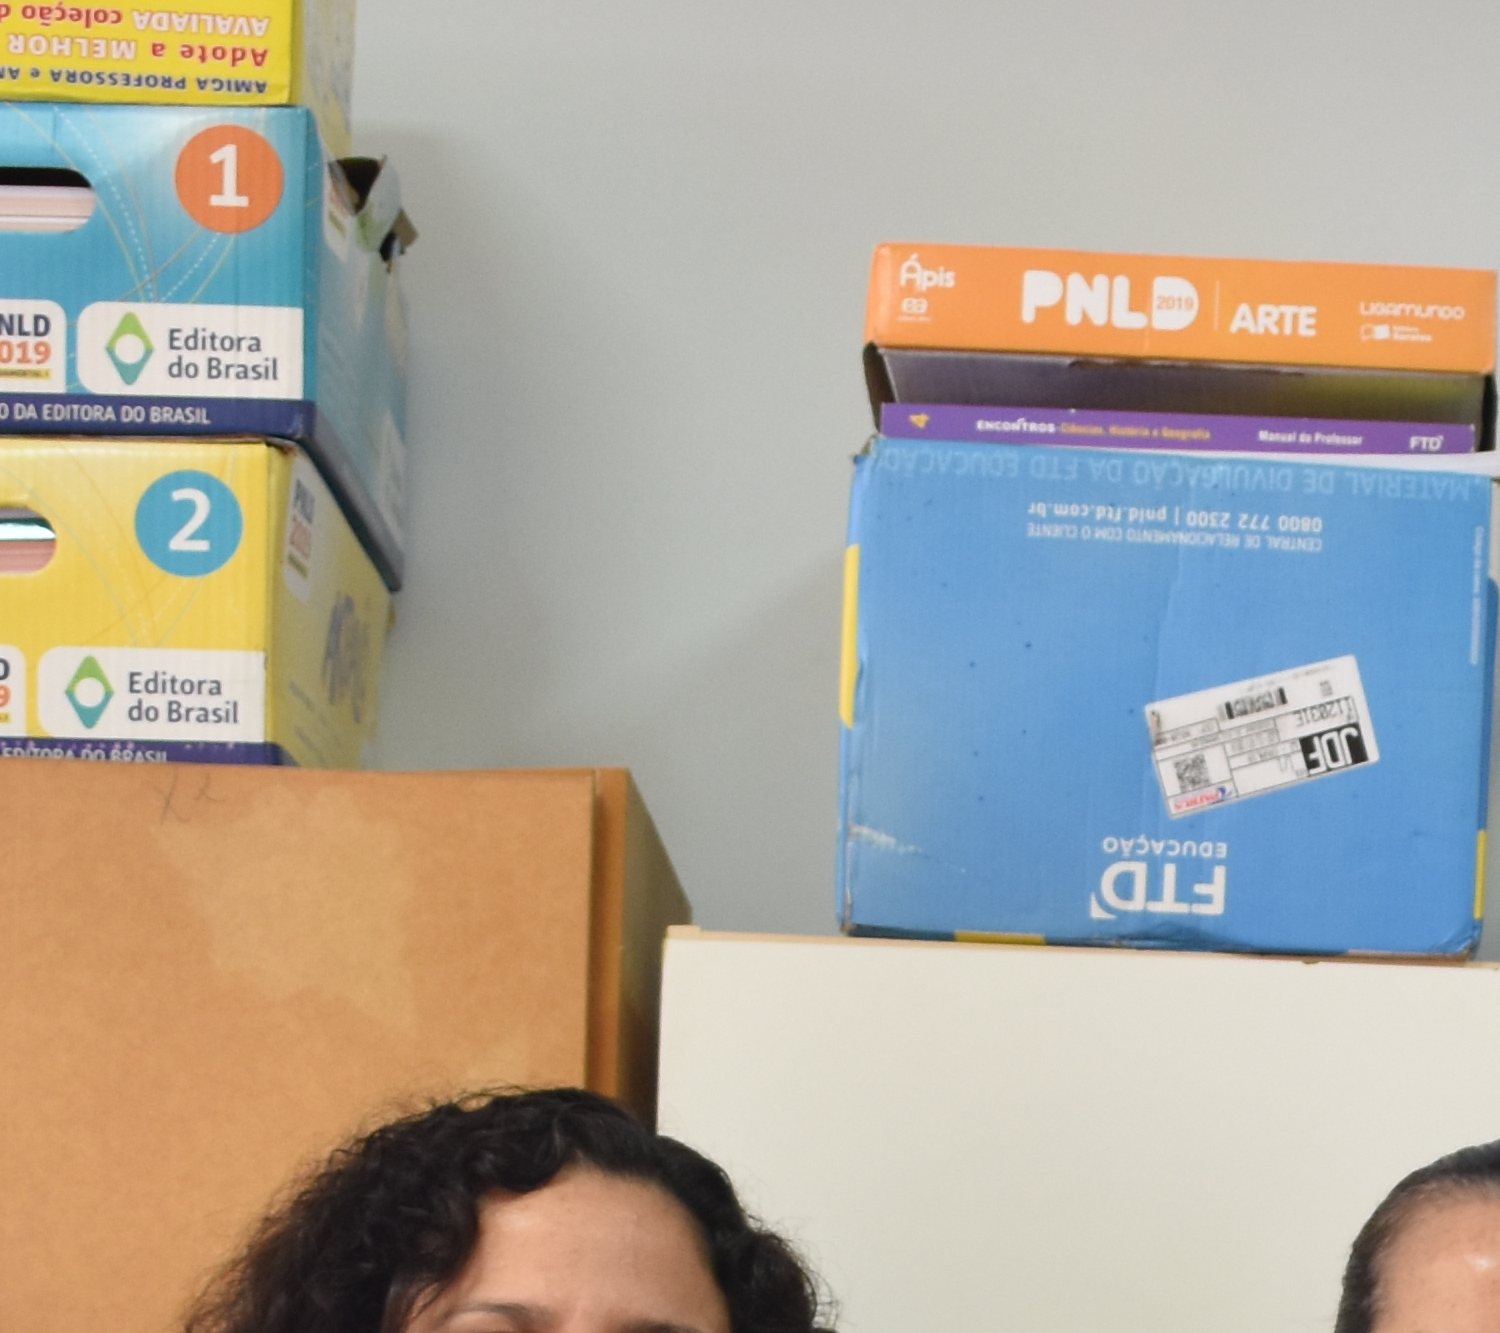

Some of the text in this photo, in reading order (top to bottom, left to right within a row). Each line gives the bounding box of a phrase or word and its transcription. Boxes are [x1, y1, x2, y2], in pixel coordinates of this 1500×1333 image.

[22, 3, 123, 28] coleção
[133, 10, 269, 37] AVALIADA
[9, 34, 136, 60] MELHOR
[150, 40, 166, 57] a
[180, 43, 268, 67] Adote
[31, 69, 40, 79] e
[52, 69, 185, 92] PROFESSORA
[196, 75, 267, 95] AMIGA
[208, 144, 250, 207] 1
[900, 254, 956, 290] Ápis
[1022, 269, 1200, 331] PNLD
[1156, 296, 1194, 311] 2019
[1230, 302, 1317, 337] ARTE
[168, 327, 262, 353] Editora
[168, 356, 278, 382] do Brasil
[13, 402, 37, 420] DA
[42, 402, 115, 422] EDITORA
[121, 405, 144, 423] DO
[150, 406, 210, 425] BRASIL
[977, 417, 1443, 451] ENCONTROS Manual Professor FTD
[1303, 472, 1334, 494] DE
[1352, 474, 1470, 500] MATERIAL
[168, 487, 211, 553] 2
[1187, 509, 1231, 527] 2300
[1238, 512, 1271, 530] 772
[1279, 516, 1322, 533] 0800
[1027, 522, 1322, 551] CENTRAL DE RELACIONAMENTO COM CLIENTE
[128, 671, 222, 697] Editora
[128, 699, 239, 725] do Brasil
[1306, 727, 1359, 775] JDF
[1103, 832, 1228, 859] EDUCAÇÃO
[1092, 860, 1227, 918] FTD
